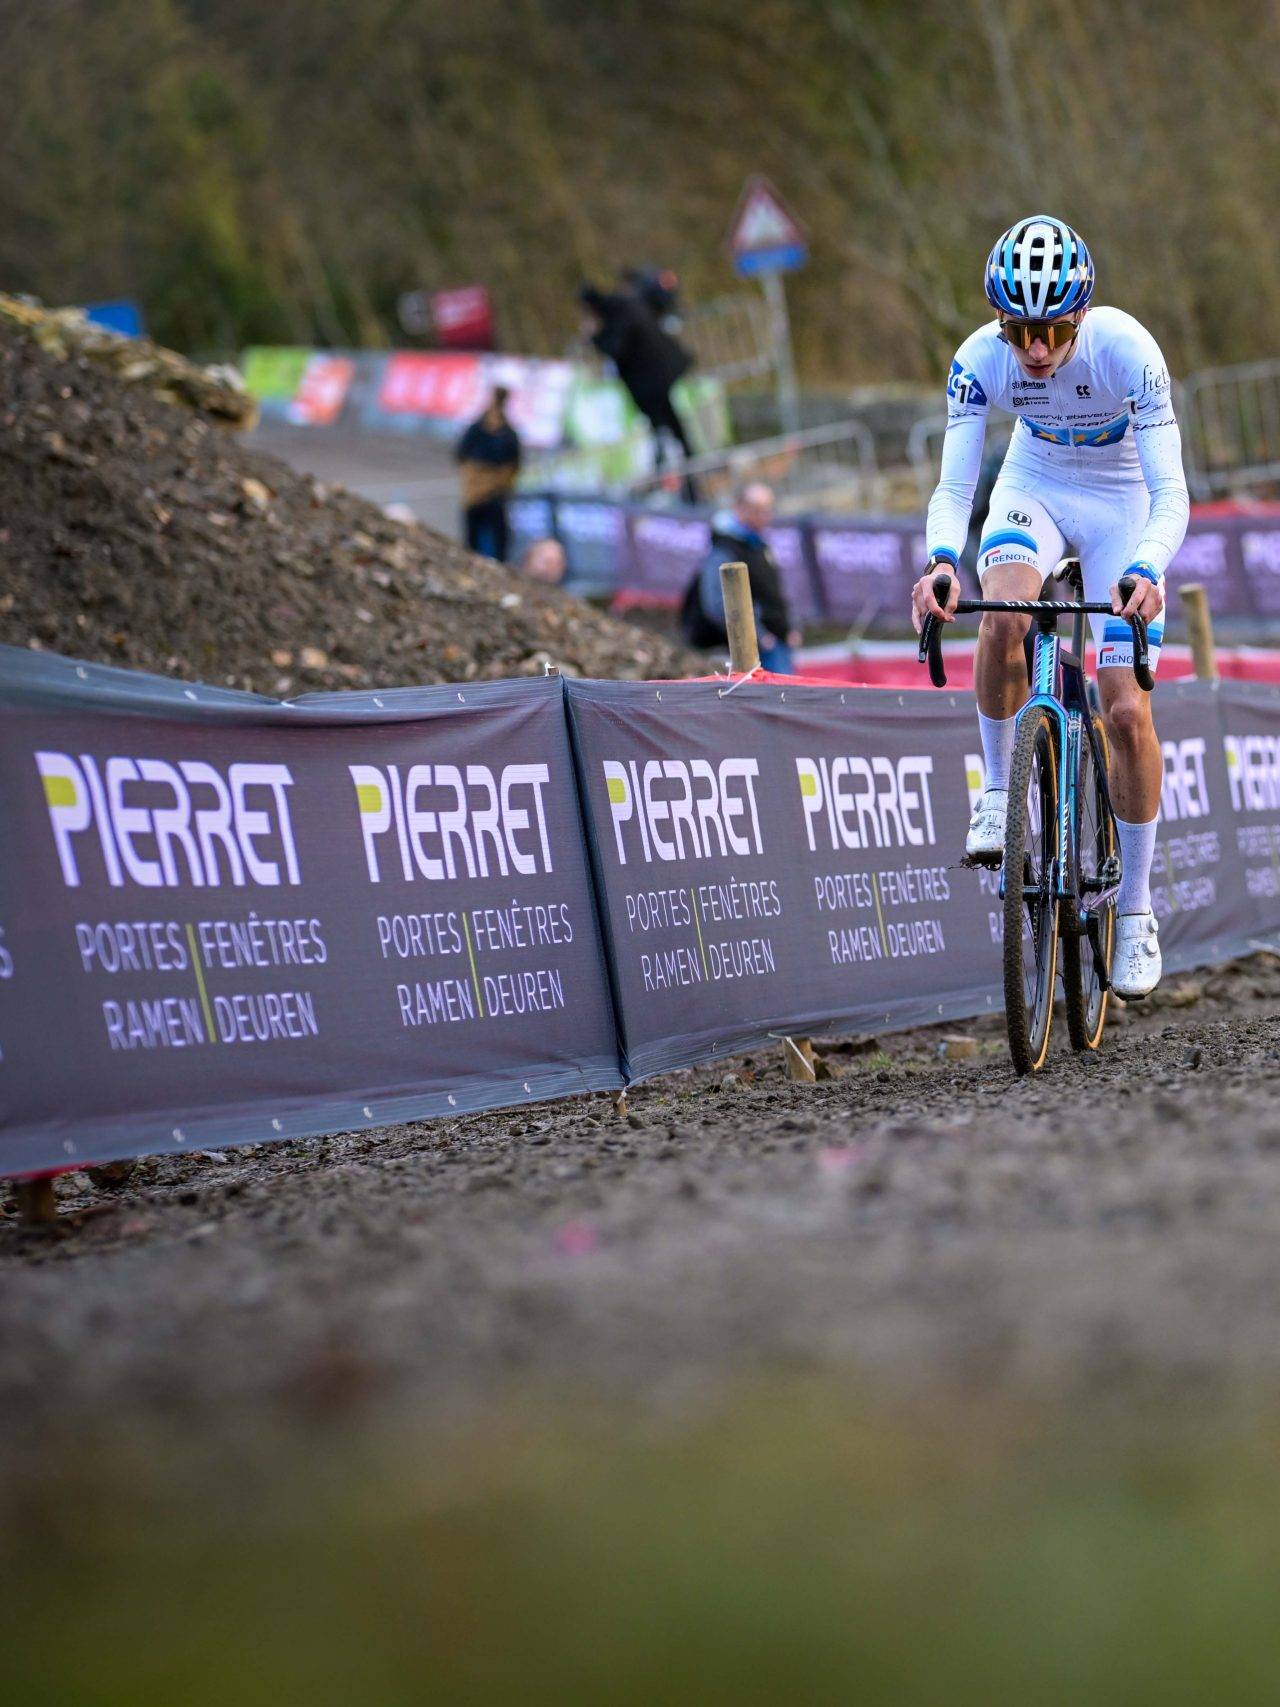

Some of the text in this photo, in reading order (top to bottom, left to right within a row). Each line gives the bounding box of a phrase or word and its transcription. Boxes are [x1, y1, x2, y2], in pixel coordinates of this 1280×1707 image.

[1105, 655, 1151, 666] RENO
[34, 751, 300, 887] PIERRET
[348, 763, 553, 883] PIERRET
[603, 758, 764, 864] PIERRET
[796, 755, 937, 851] PIERRET
[626, 876, 781, 932] PORTES FENÊTRES
[814, 872, 873, 911] PORTES
[879, 863, 950, 905] FENÊTRES
[75, 922, 188, 973] PORTES
[198, 911, 328, 969] FENÊTRES
[377, 898, 573, 959] PORTES FENÊTRES
[828, 925, 883, 964] RAMEN
[887, 919, 945, 958] DEUREN
[640, 938, 776, 992] RAMEN DEUREN
[102, 992, 319, 1050] RAMEN DEUREN
[397, 969, 565, 1027] RAMEN DEUREN
